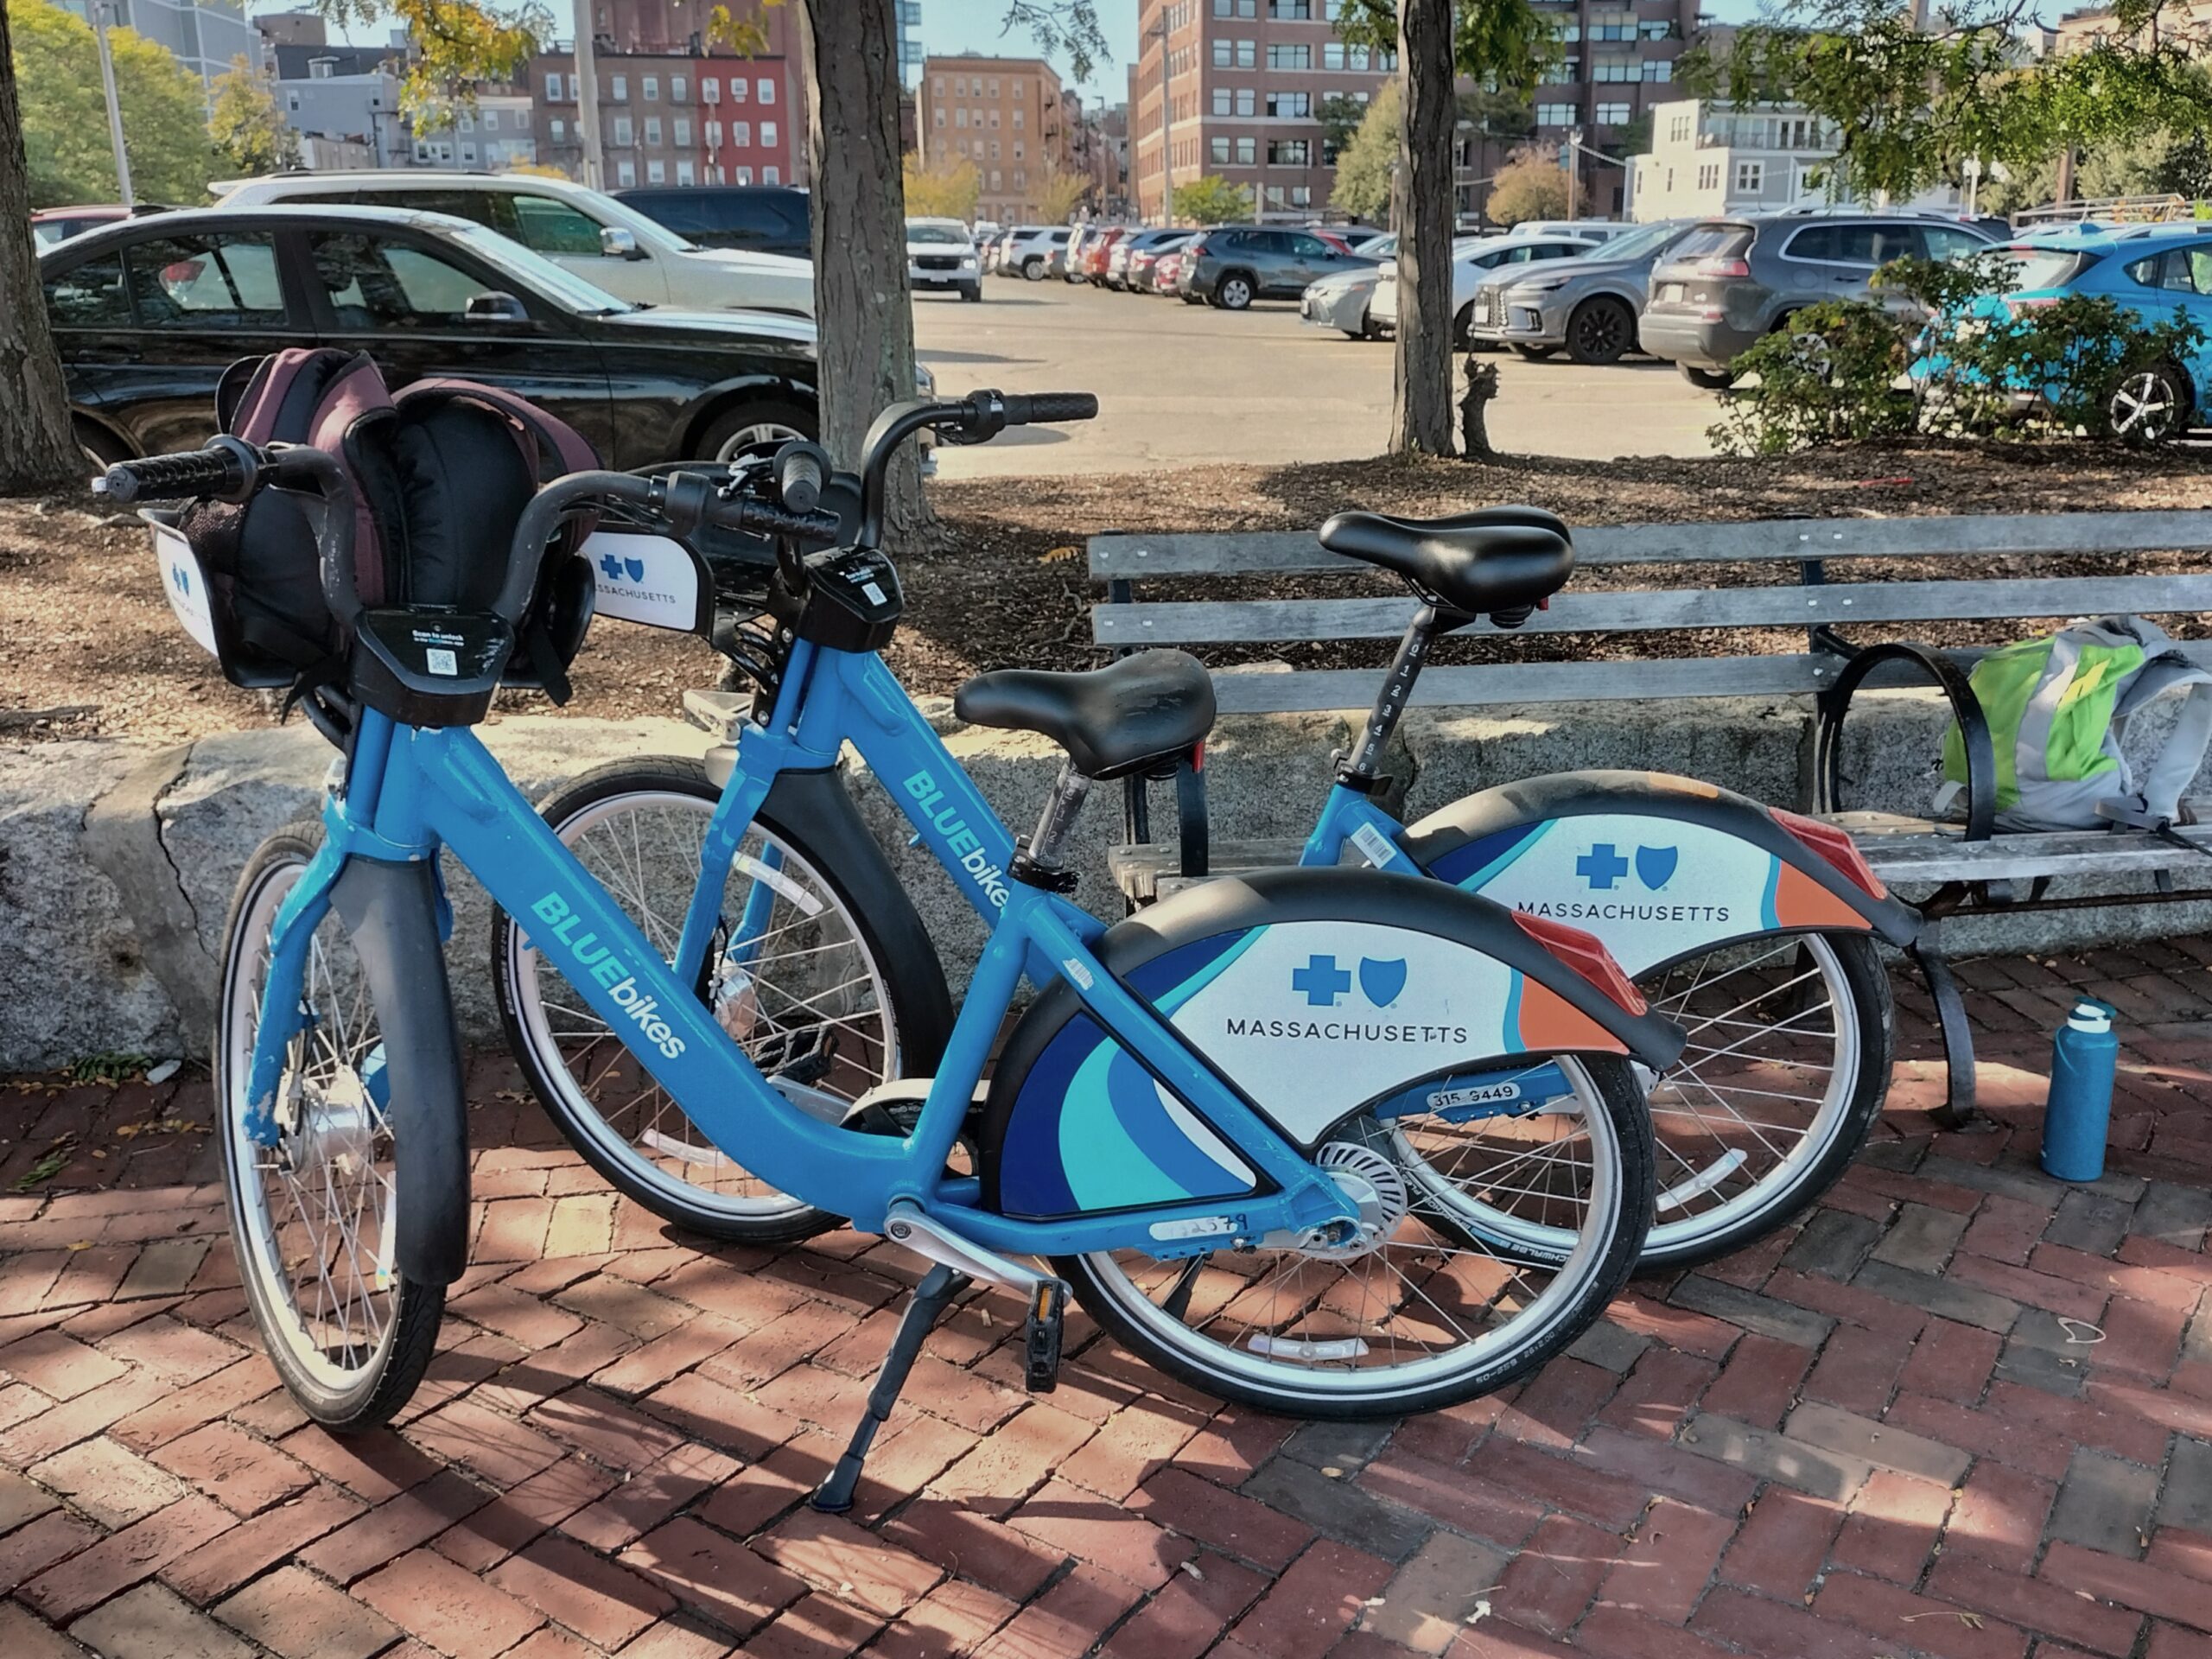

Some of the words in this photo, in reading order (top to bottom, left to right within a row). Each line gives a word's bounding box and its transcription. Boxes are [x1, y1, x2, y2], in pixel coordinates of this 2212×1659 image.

[595, 584, 677, 604] SSACHUSETTS
[903, 770, 1010, 907] BLUEbike
[1518, 901, 1729, 922] MASSACHUSETTS
[531, 891, 686, 1059] BLUEbikes
[1227, 1018, 1467, 1044] MASSACHUSETTS
[1510, 1243, 1571, 1264] CHWALBE
